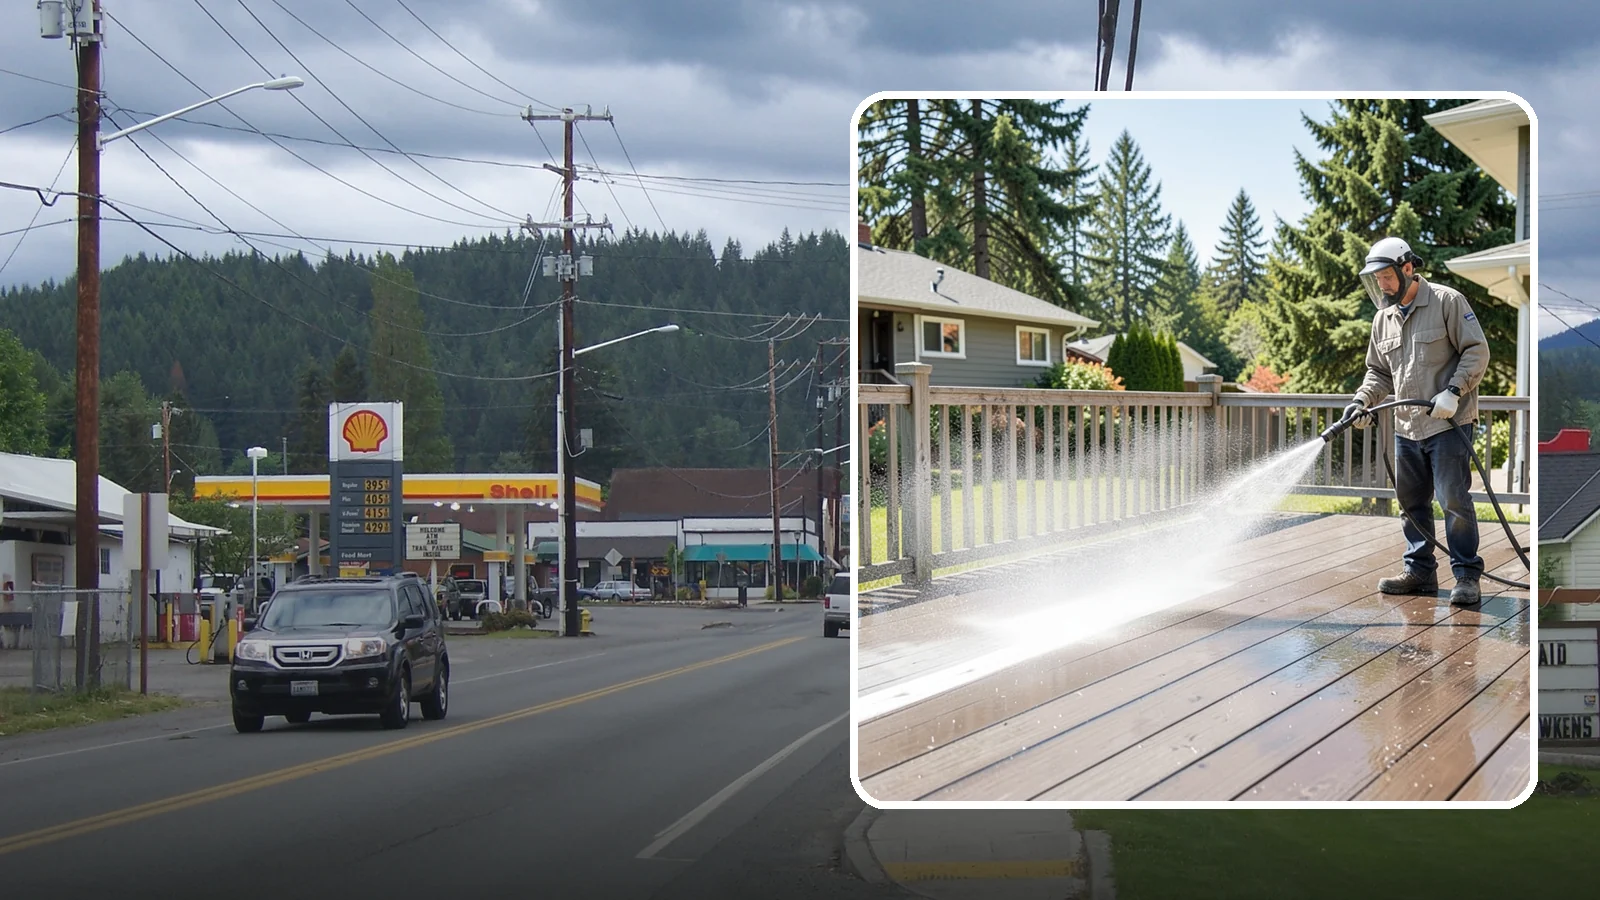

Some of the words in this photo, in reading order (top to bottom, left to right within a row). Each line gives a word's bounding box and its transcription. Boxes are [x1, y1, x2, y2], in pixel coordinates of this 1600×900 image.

[366, 480, 383, 490] 395
[490, 484, 547, 499] Shell
[366, 494, 383, 504] 405
[366, 508, 383, 518] 415
[366, 522, 383, 532] 429
[1538, 643, 1567, 665] AID
